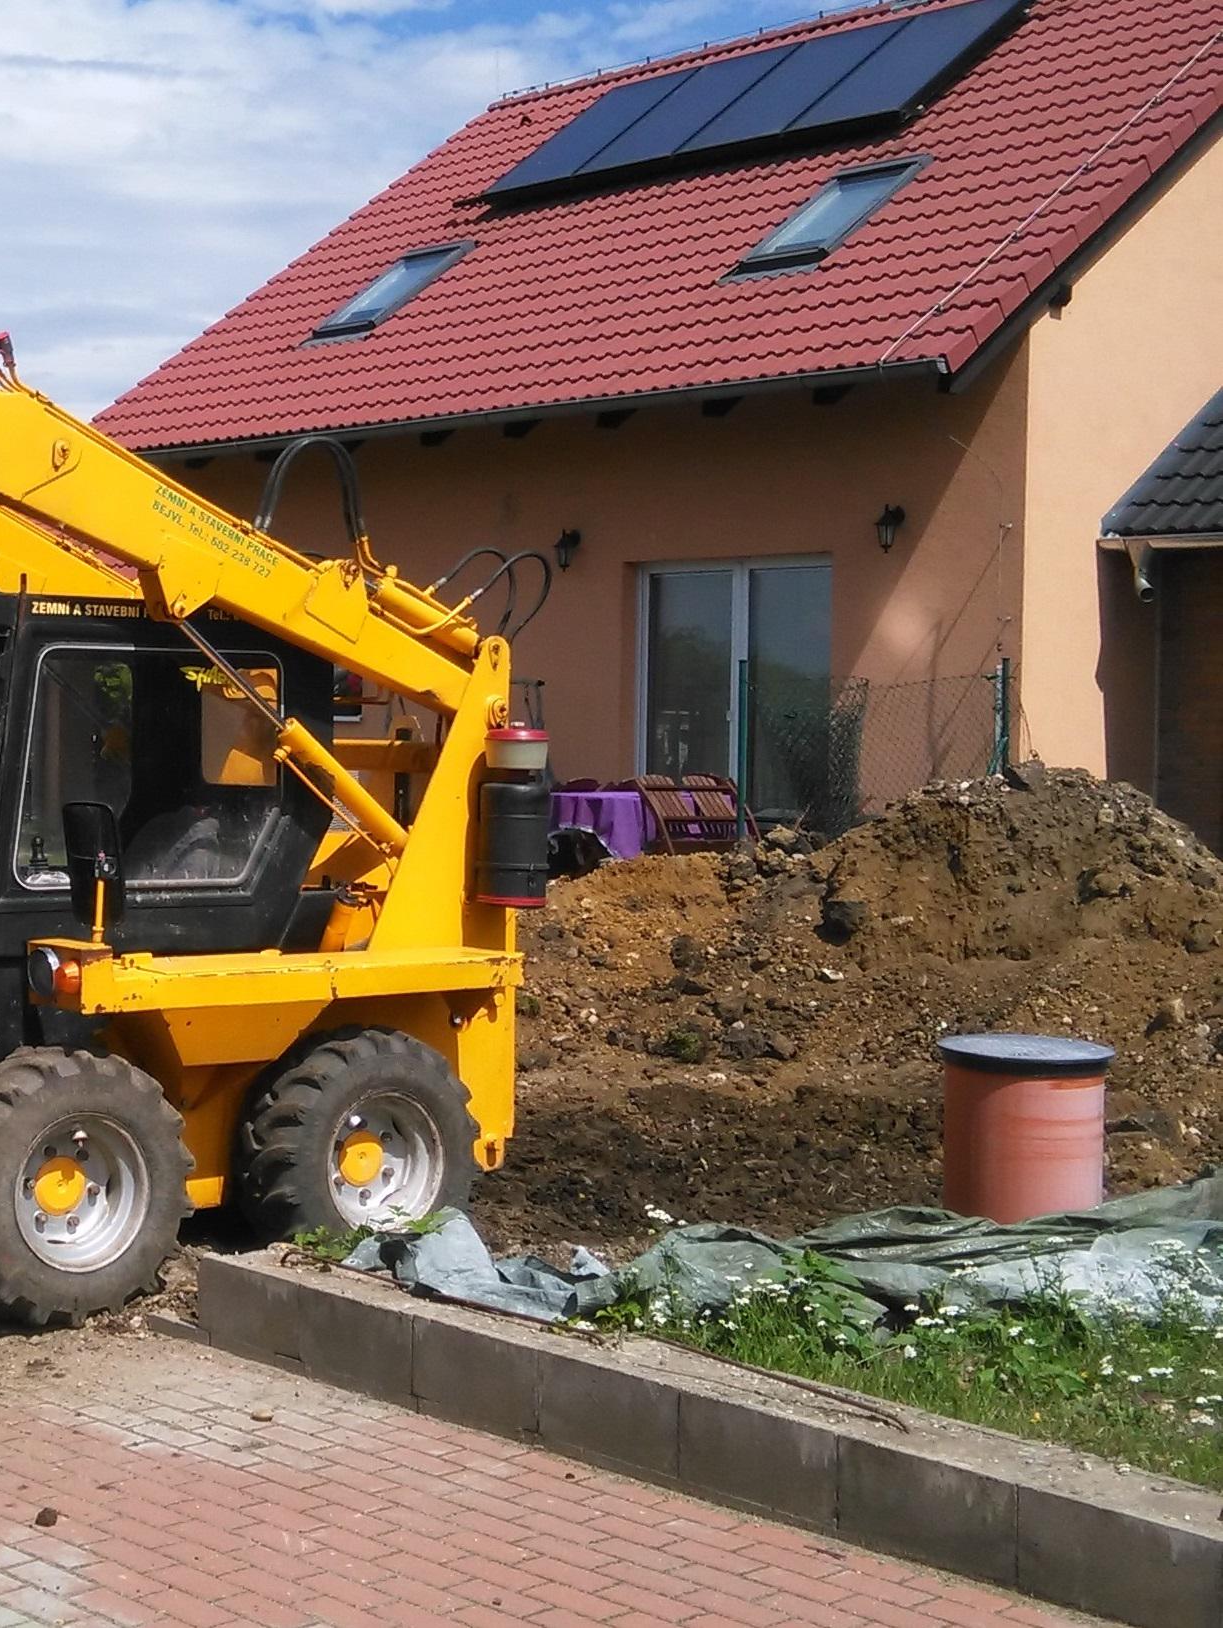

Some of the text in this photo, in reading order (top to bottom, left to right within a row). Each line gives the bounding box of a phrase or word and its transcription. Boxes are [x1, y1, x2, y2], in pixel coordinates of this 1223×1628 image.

[189, 507, 196, 516] A
[253, 562, 271, 578] 727
[31, 601, 70, 615] ZEMNÍ
[73, 603, 82, 616] A
